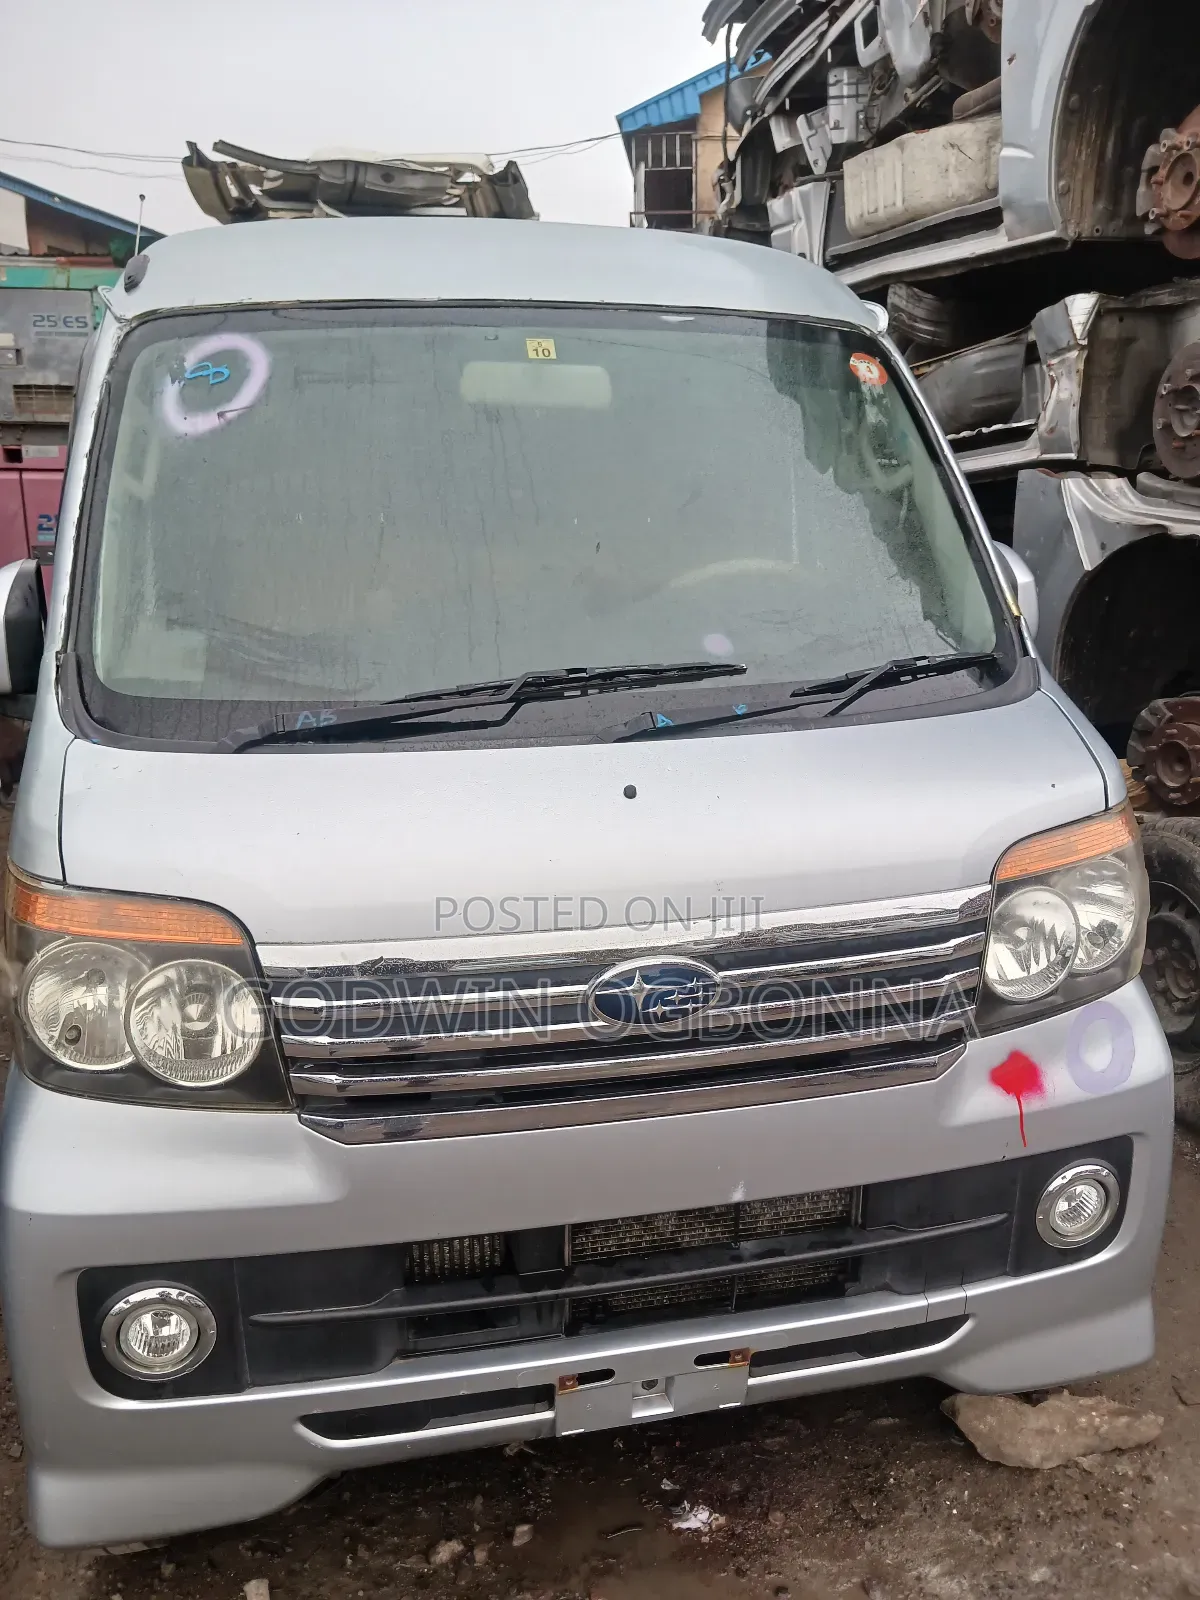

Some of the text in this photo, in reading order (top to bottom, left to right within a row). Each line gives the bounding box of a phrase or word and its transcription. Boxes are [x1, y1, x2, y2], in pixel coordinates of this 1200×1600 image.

[32, 314, 89, 329] 25 ES
[532, 348, 551, 358] 10
[37, 514, 59, 532] 2
